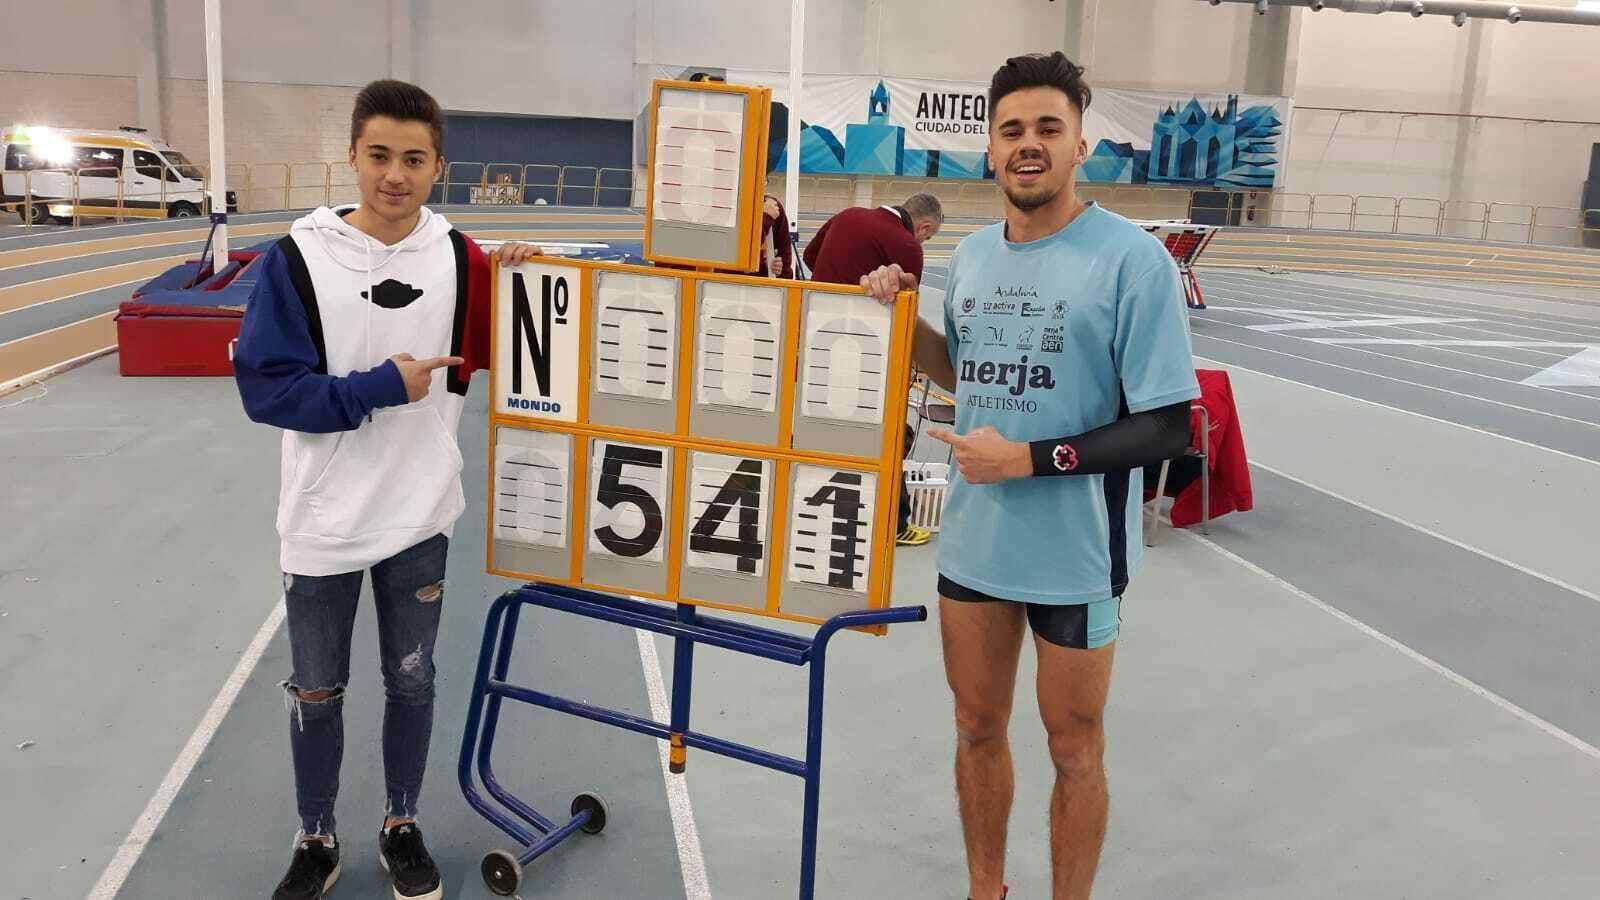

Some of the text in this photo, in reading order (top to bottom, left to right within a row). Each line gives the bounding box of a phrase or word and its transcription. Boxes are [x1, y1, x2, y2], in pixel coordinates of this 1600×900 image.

[916, 92, 986, 123] ANTEQ
[915, 121, 985, 135] CIUDAD DEL
[511, 271, 569, 398] Nº
[960, 354, 1056, 396] nerja
[507, 397, 561, 413] MONDO
[967, 393, 1037, 413] ATLETISMO
